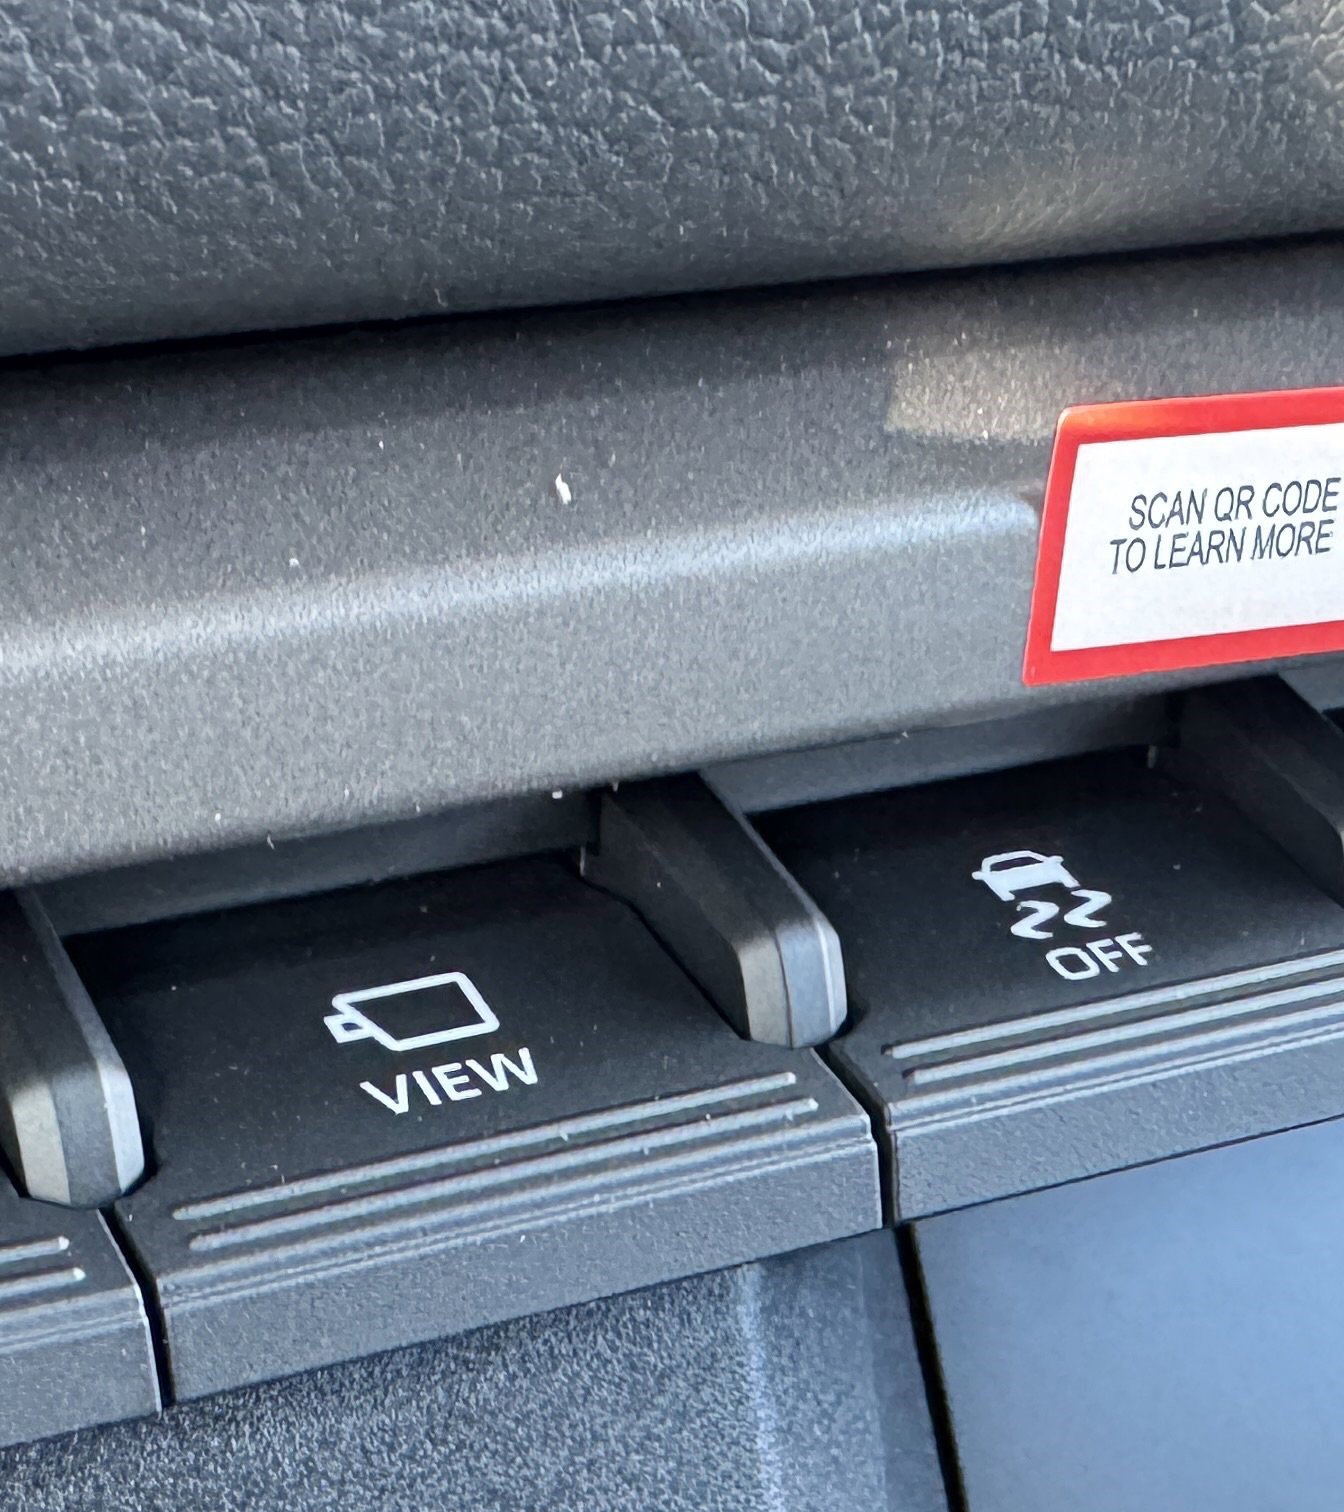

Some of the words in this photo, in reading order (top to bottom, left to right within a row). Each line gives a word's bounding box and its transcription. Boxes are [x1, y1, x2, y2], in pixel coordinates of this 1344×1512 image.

[1129, 488, 1208, 531] SCAN
[1214, 485, 1255, 522] QR
[1262, 477, 1342, 518] CODE
[1109, 537, 1146, 574] TO
[1153, 526, 1247, 569] LEARN
[1250, 519, 1335, 560] MORE
[1045, 931, 1153, 981] OFF
[359, 1047, 539, 1116] VIEW
